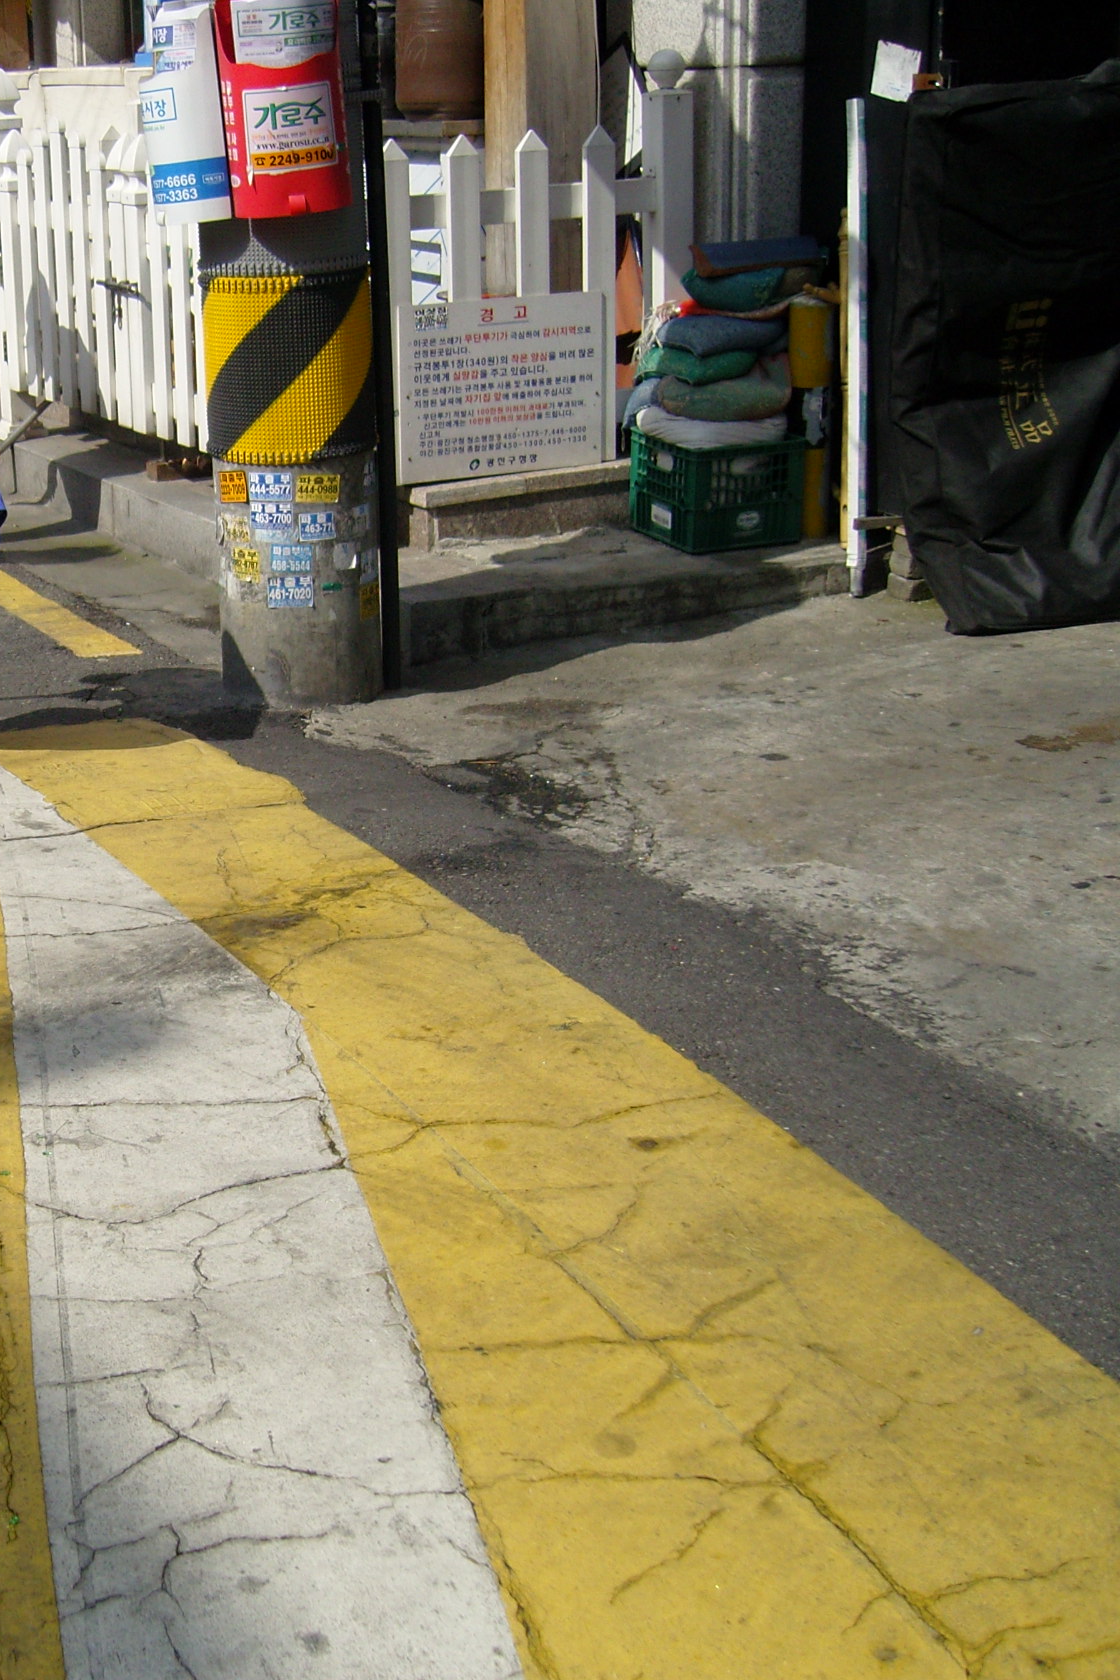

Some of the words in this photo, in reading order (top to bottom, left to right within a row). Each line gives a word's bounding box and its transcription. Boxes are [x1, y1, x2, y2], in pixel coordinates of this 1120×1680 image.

[268, 8, 320, 30] 가로수
[141, 99, 166, 119] 시장
[253, 97, 326, 130] 가로수
[269, 149, 334, 166] 2249-9100
[250, 484, 290, 495] 444-5577
[255, 513, 291, 524] 463-7700
[269, 588, 311, 600] 461-7020
